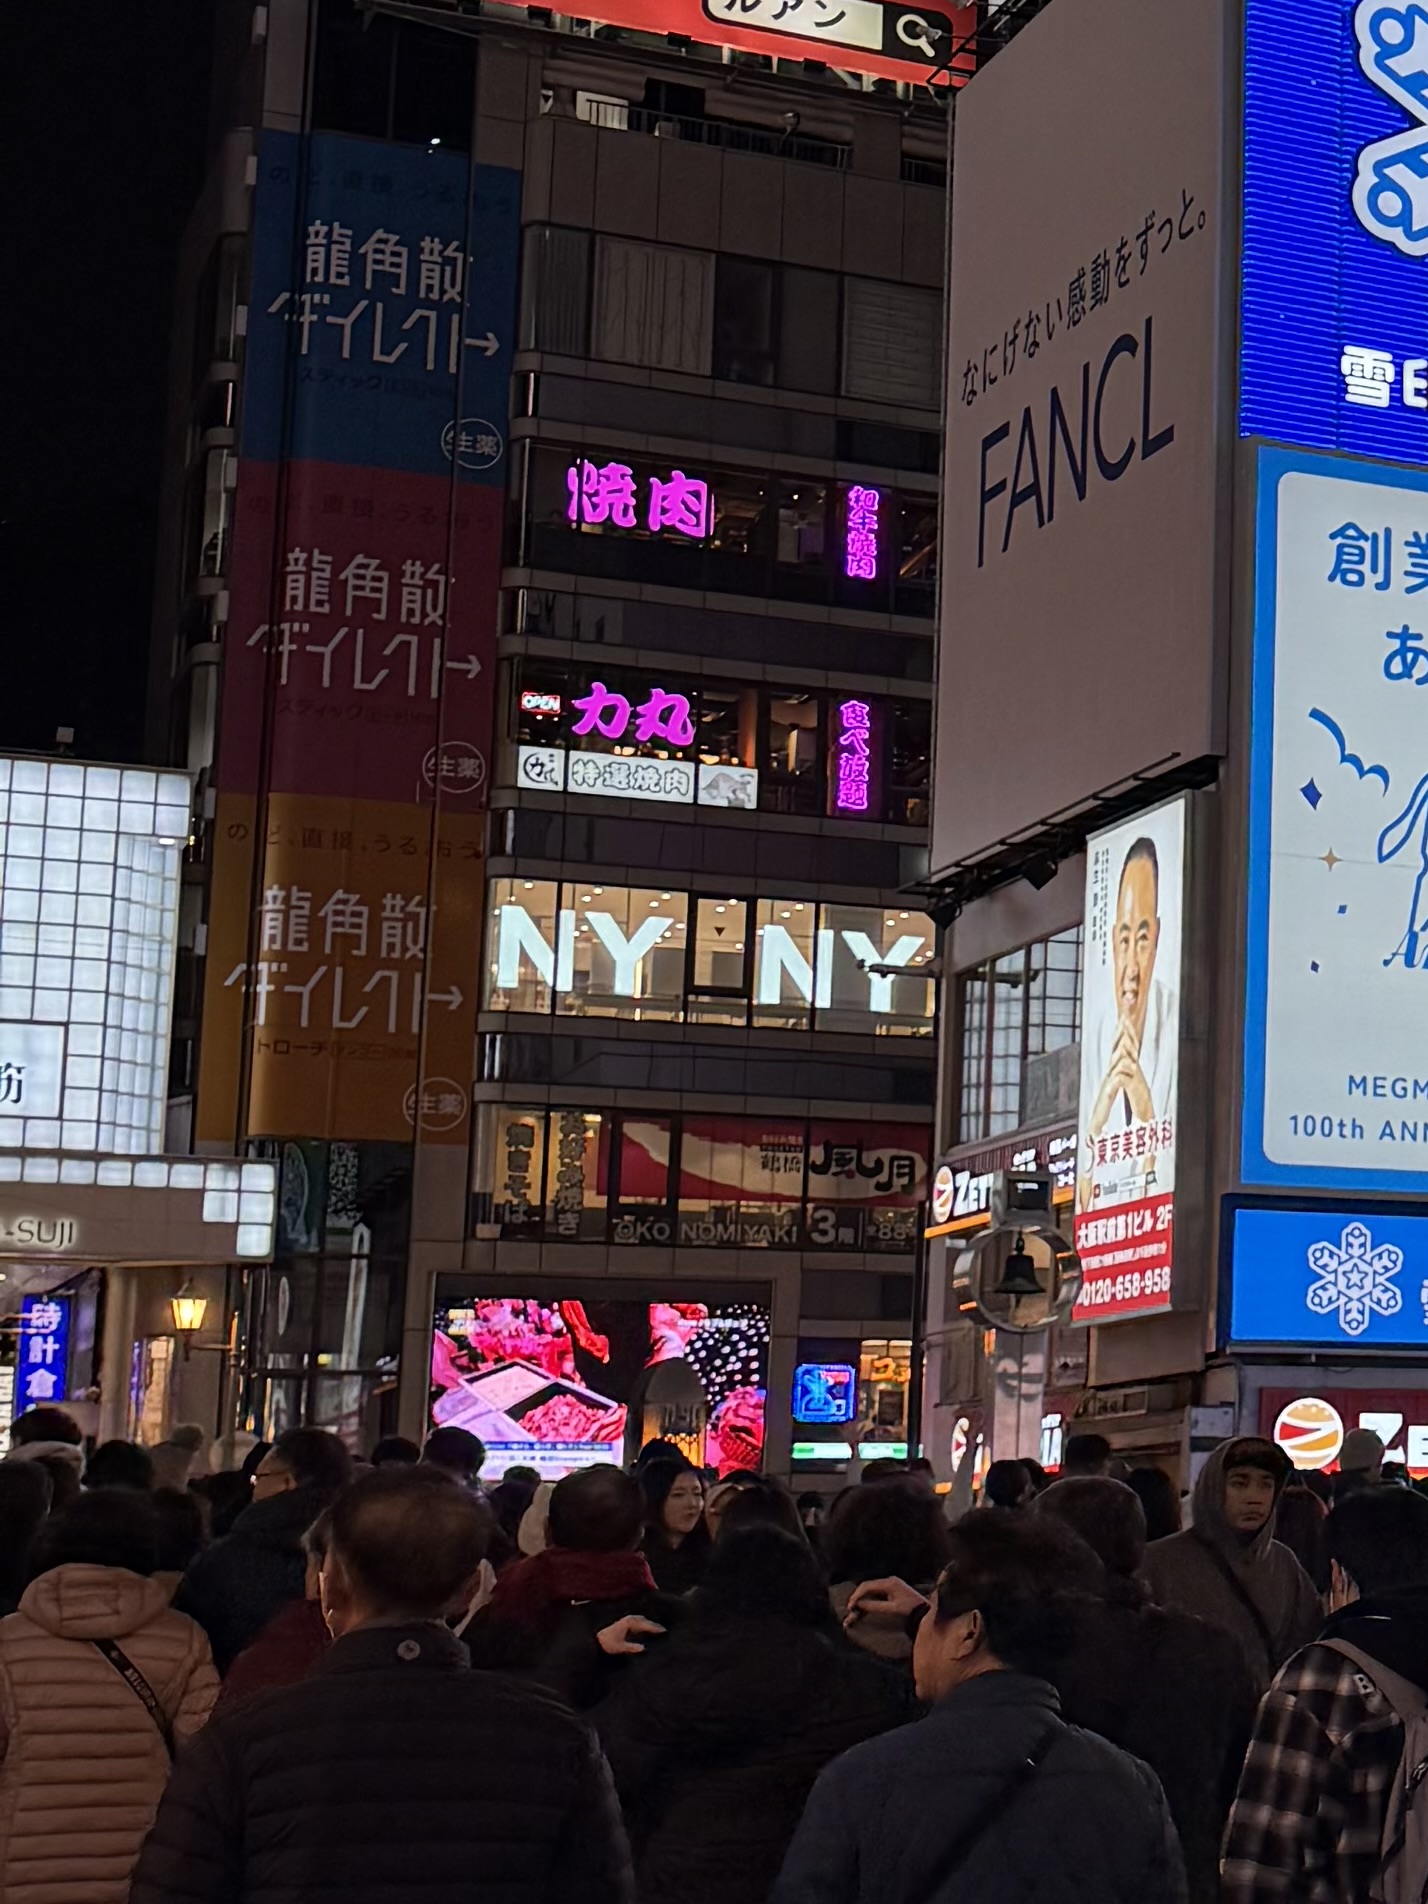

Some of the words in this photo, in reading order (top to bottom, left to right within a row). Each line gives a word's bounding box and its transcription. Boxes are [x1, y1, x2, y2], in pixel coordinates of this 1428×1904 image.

[304, 218, 466, 304] 龍角散
[960, 187, 1207, 407] なにげない感動をずっと。
[977, 315, 1175, 569] FANCL
[566, 457, 714, 539] 焼肉
[283, 546, 448, 627] 龍角散
[523, 694, 560, 711] OPEN
[571, 681, 697, 746] 力丸
[572, 758, 690, 797] 特選焼肉
[257, 884, 437, 960] 龍角散
[497, 903, 674, 997] NY
[760, 924, 925, 1014] NY
[809, 1139, 917, 1193] 風月
[1288, 1114, 1365, 1143] 100th
